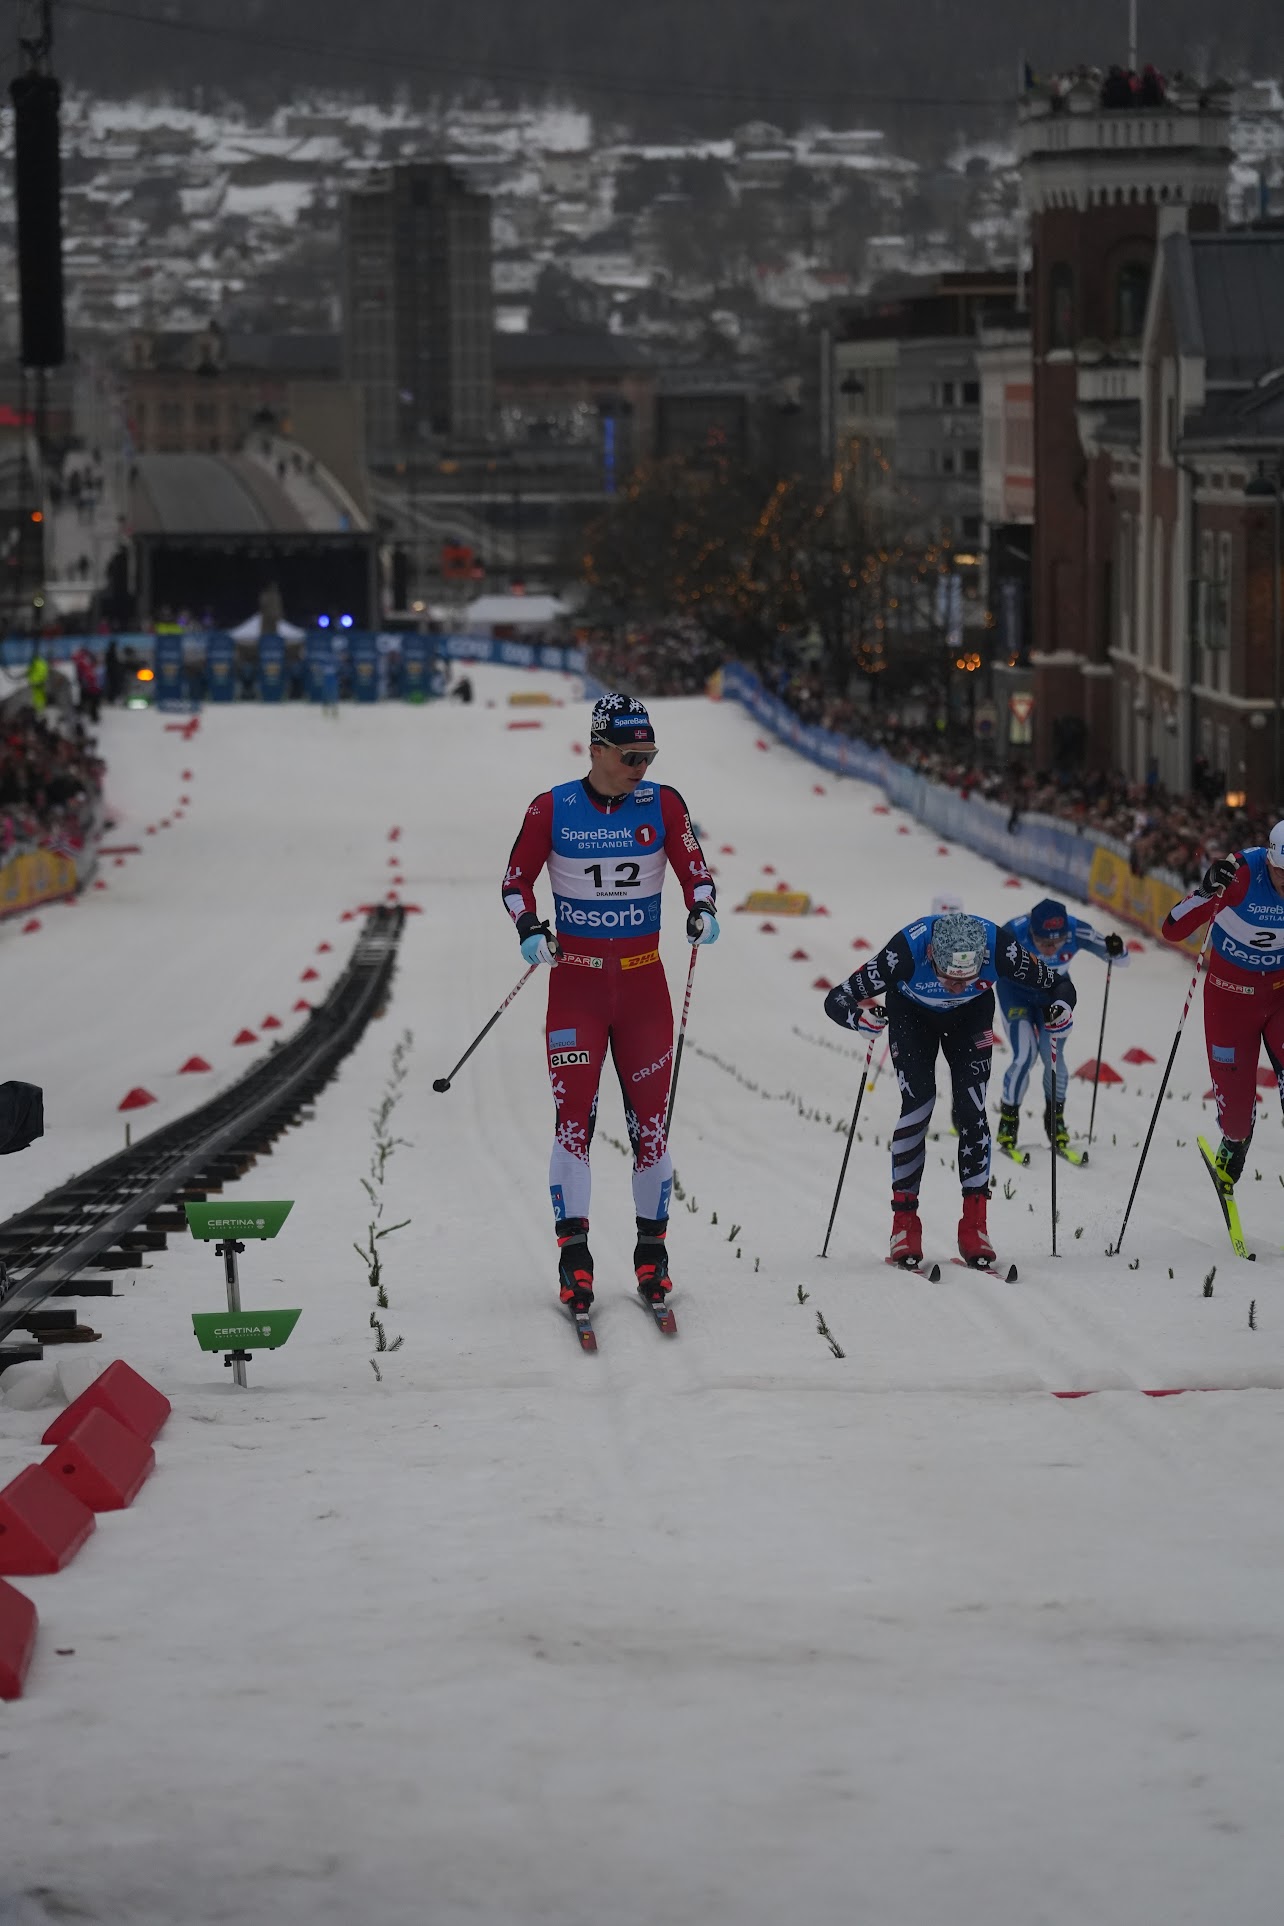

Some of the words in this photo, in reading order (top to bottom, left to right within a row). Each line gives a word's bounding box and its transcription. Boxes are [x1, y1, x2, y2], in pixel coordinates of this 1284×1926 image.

[561, 827, 632, 842] SpareBank
[640, 827, 650, 843] 1
[578, 840, 634, 850] ØSTLANDET
[584, 862, 641, 888] 12
[560, 900, 645, 928] Resorb
[1250, 931, 1277, 948] 2
[627, 953, 657, 966] DHL
[1215, 978, 1244, 992] SPAR
[207, 1219, 255, 1227] CERTINA
[213, 1326, 261, 1335] CERTINA
